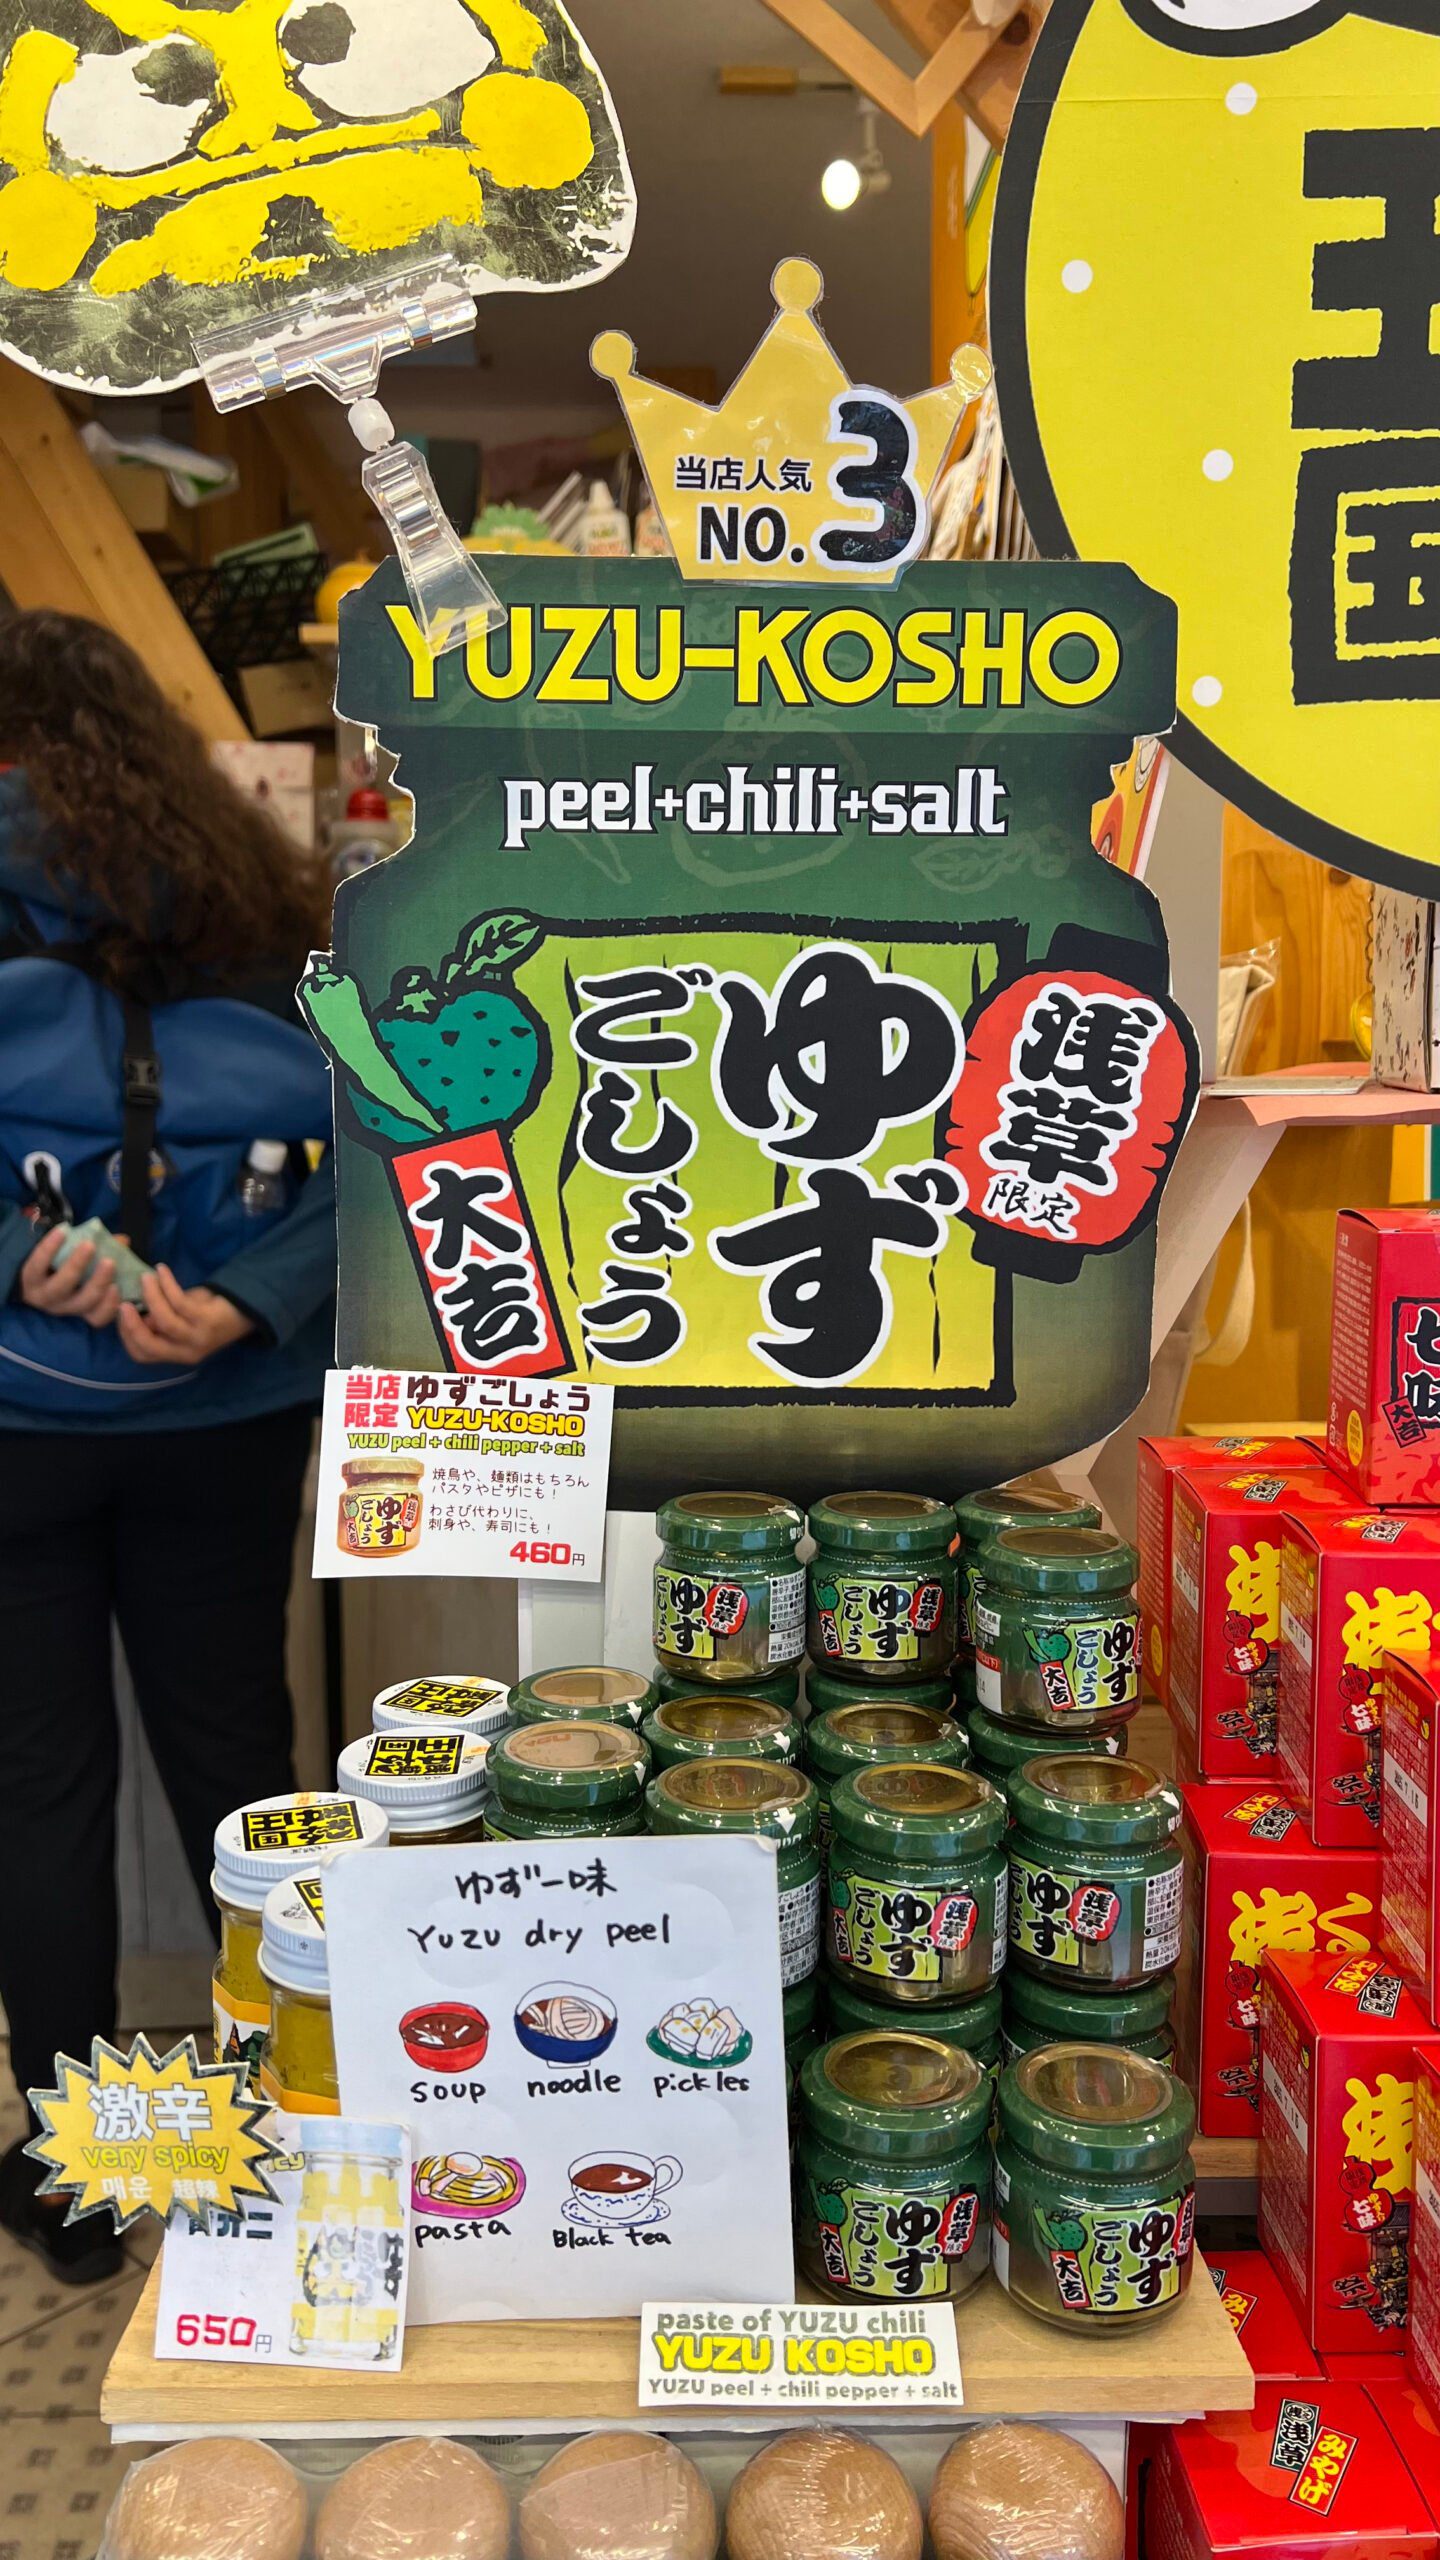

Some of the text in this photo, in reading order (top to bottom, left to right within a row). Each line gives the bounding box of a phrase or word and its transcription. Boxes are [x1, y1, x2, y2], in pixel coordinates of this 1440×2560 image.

[676, 456, 812, 492] 当店人気
[700, 399, 917, 563] NO. 3
[382, 602, 1123, 709] YUZU-KOSHO
[985, 988, 1161, 1188] 浅草
[573, 964, 714, 1364] ごしょう
[711, 945, 965, 1385] ゆず
[986, 1178, 1074, 1235] 限定
[412, 1164, 544, 1364] 大吉
[345, 1374, 401, 1400] 当店
[406, 1375, 591, 1412] ゆずごしょう
[344, 1402, 399, 1428] 限定
[407, 1406, 585, 1437] YUZU-KOSHO
[1390, 1403, 1421, 1441] 大吉
[347, 1432, 389, 1449] YUZU
[391, 1432, 427, 1453] peel
[444, 1434, 480, 1451] chili
[481, 1437, 538, 1457] pepper
[554, 1439, 586, 1457] salt
[669, 1576, 707, 1654] ゆず
[820, 1612, 840, 1651] 大吉
[843, 1584, 867, 1655] ごしょう
[867, 1582, 912, 1659] ゆず
[1076, 1628, 1102, 1705] ごしょう
[1102, 1619, 1137, 1703] ゆず
[1042, 1666, 1071, 1706] 大吉
[455, 1858, 618, 1904] ゆず一味
[525, 1918, 583, 1954] dry
[606, 1913, 671, 1948] peel
[833, 1912, 850, 1957] 大吉
[854, 1886, 880, 1966] ごしょう
[879, 1889, 933, 1979] ゆず
[1025, 1869, 1073, 1957] ゆず
[527, 2070, 622, 2098] noodle
[88, 2083, 213, 2144] 激辛
[82, 2141, 229, 2175] very spicy
[414, 2220, 672, 2249] pasta Black tea
[947, 2197, 976, 2243] 浅草
[1352, 2199, 1378, 2230] 七味
[822, 2231, 844, 2277] 大吉
[853, 2198, 884, 2288] ごしょう
[884, 2199, 943, 2296] ゆず
[1093, 2218, 1130, 2307] ごしょう
[1127, 2210, 1177, 2306] ゆず
[1055, 2255, 1085, 2302] 大吉
[656, 2309, 926, 2334] paste of YUZU chili
[652, 2332, 935, 2376] YUZU KOSHO
[648, 2379, 705, 2395] YUZU
[710, 2380, 755, 2397] peel
[778, 2380, 820, 2398] chili
[826, 2382, 898, 2401] pepper
[921, 2381, 958, 2399] salt
[1297, 2433, 1349, 2505] みやげ
